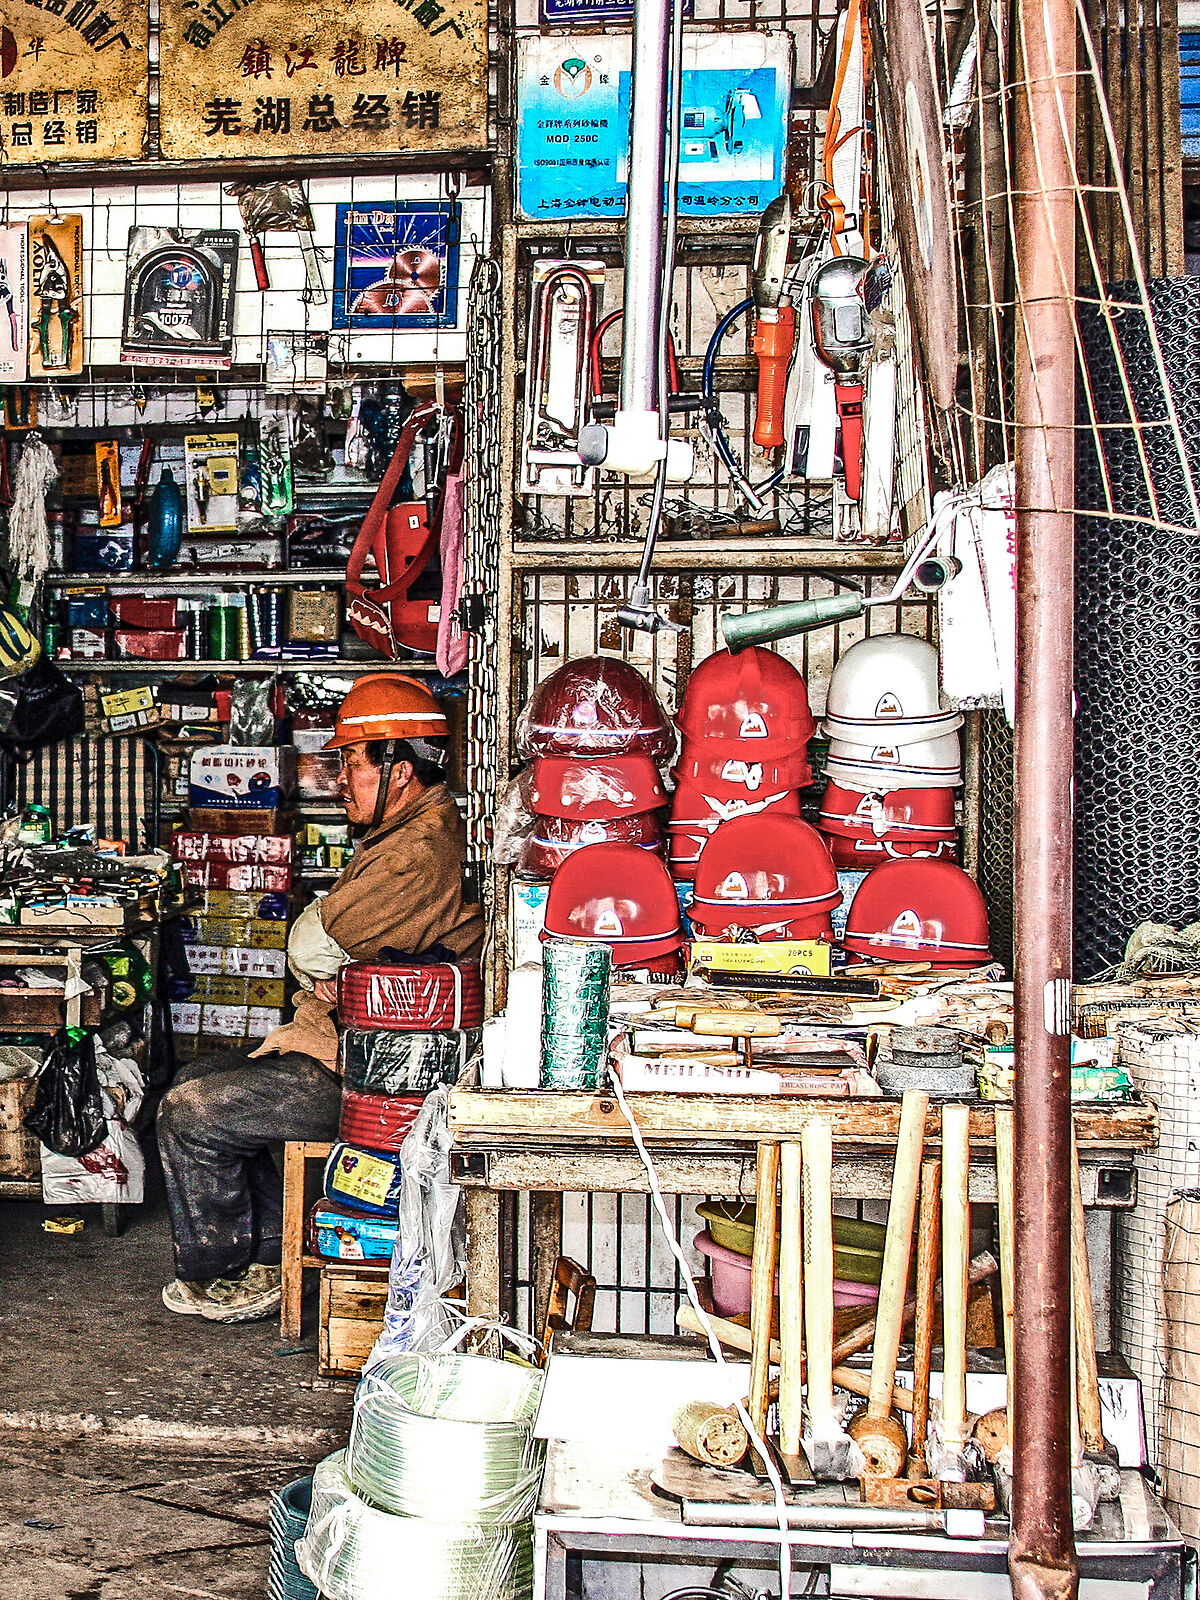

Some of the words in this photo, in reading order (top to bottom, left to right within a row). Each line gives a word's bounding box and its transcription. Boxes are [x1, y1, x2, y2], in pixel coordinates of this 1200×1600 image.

[237, 37, 408, 79] 鎮江龍牌
[540, 75, 549, 85] 金
[203, 91, 441, 137] 芜湖总经销
[574, 135, 598, 143] 250C
[344, 211, 369, 225] Jin
[372, 211, 394, 225] Da
